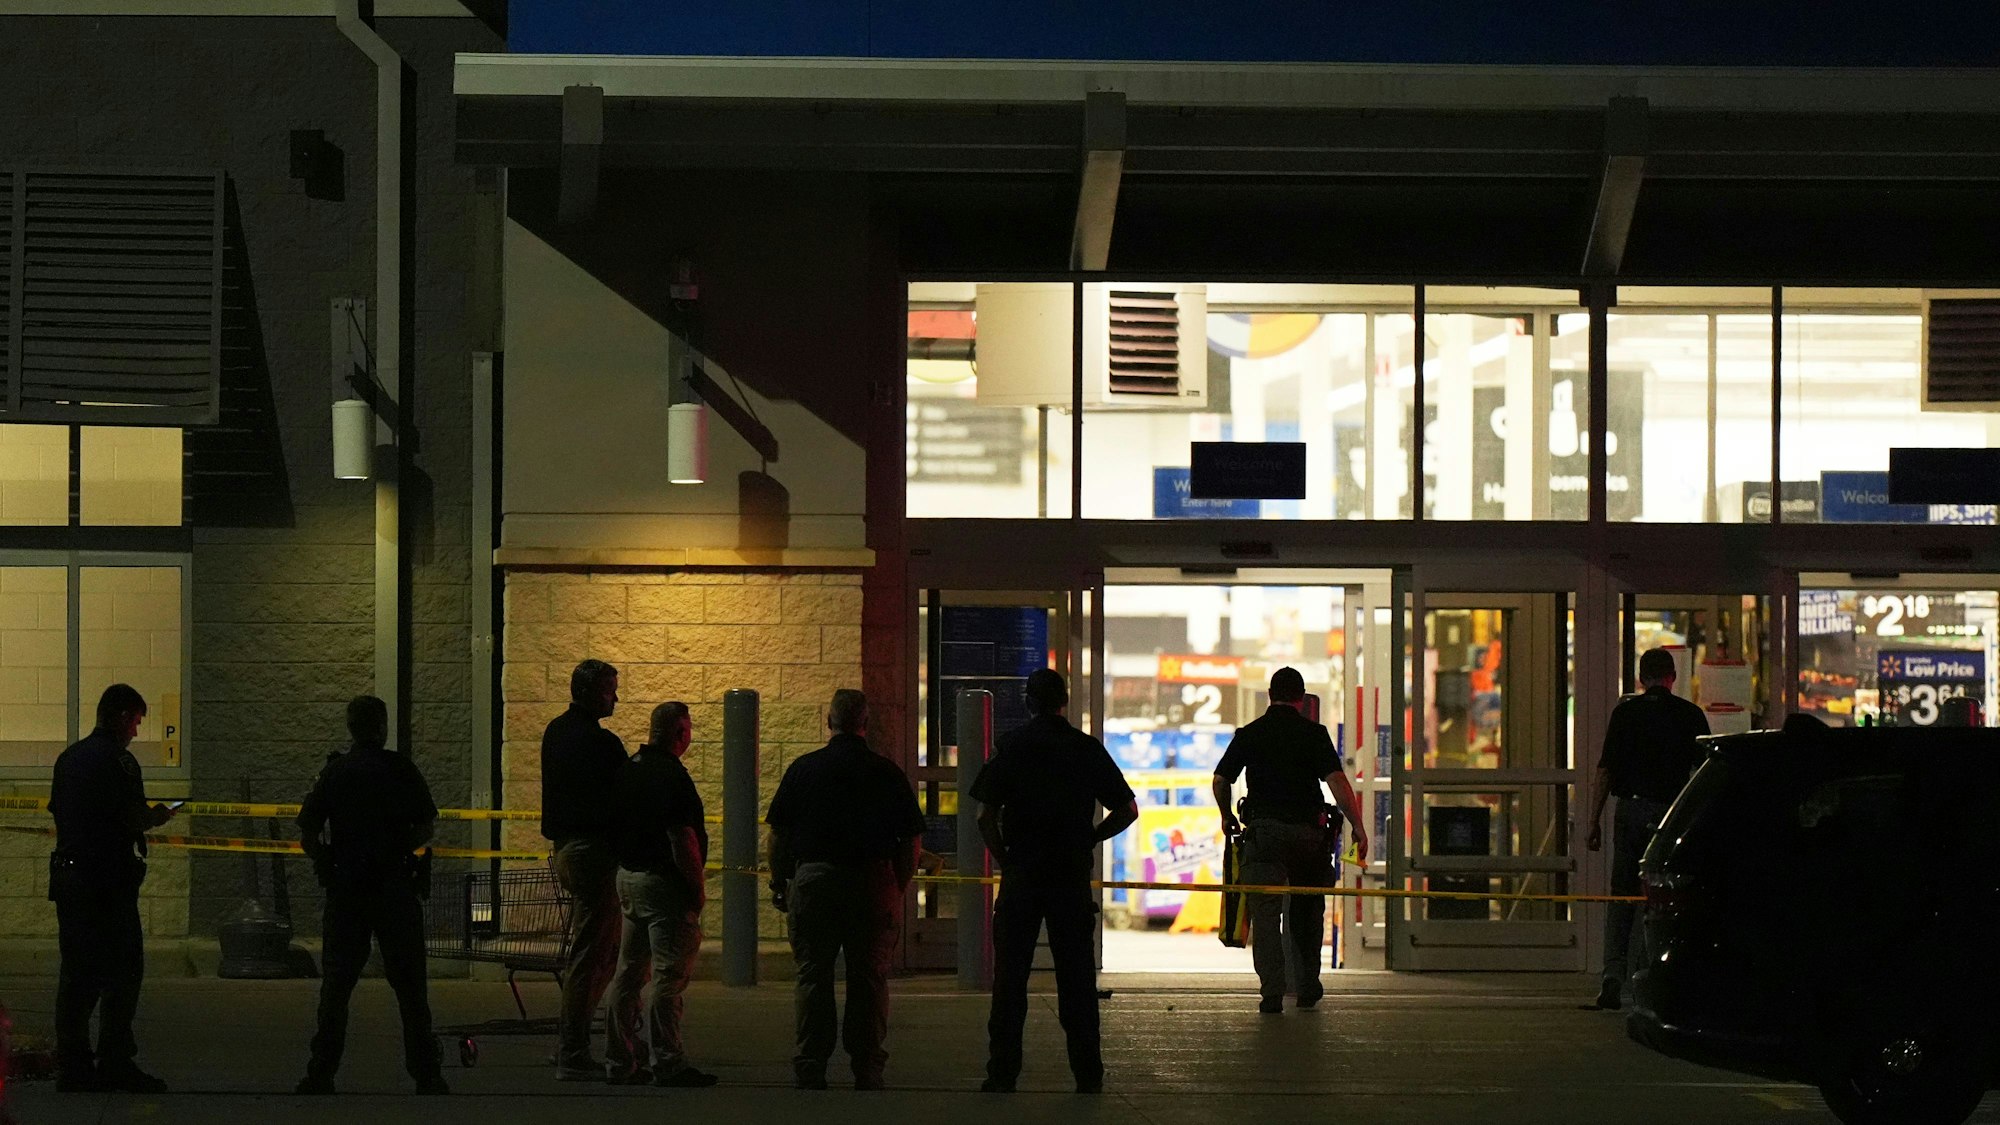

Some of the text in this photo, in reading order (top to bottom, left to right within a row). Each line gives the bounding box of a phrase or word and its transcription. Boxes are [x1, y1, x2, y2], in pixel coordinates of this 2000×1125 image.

[1174, 478, 1191, 492] W
[1841, 490, 1889, 504] Welco
[1905, 657, 1975, 677] Low Price
[166, 725, 176, 739] P
[169, 746, 173, 759] 1
